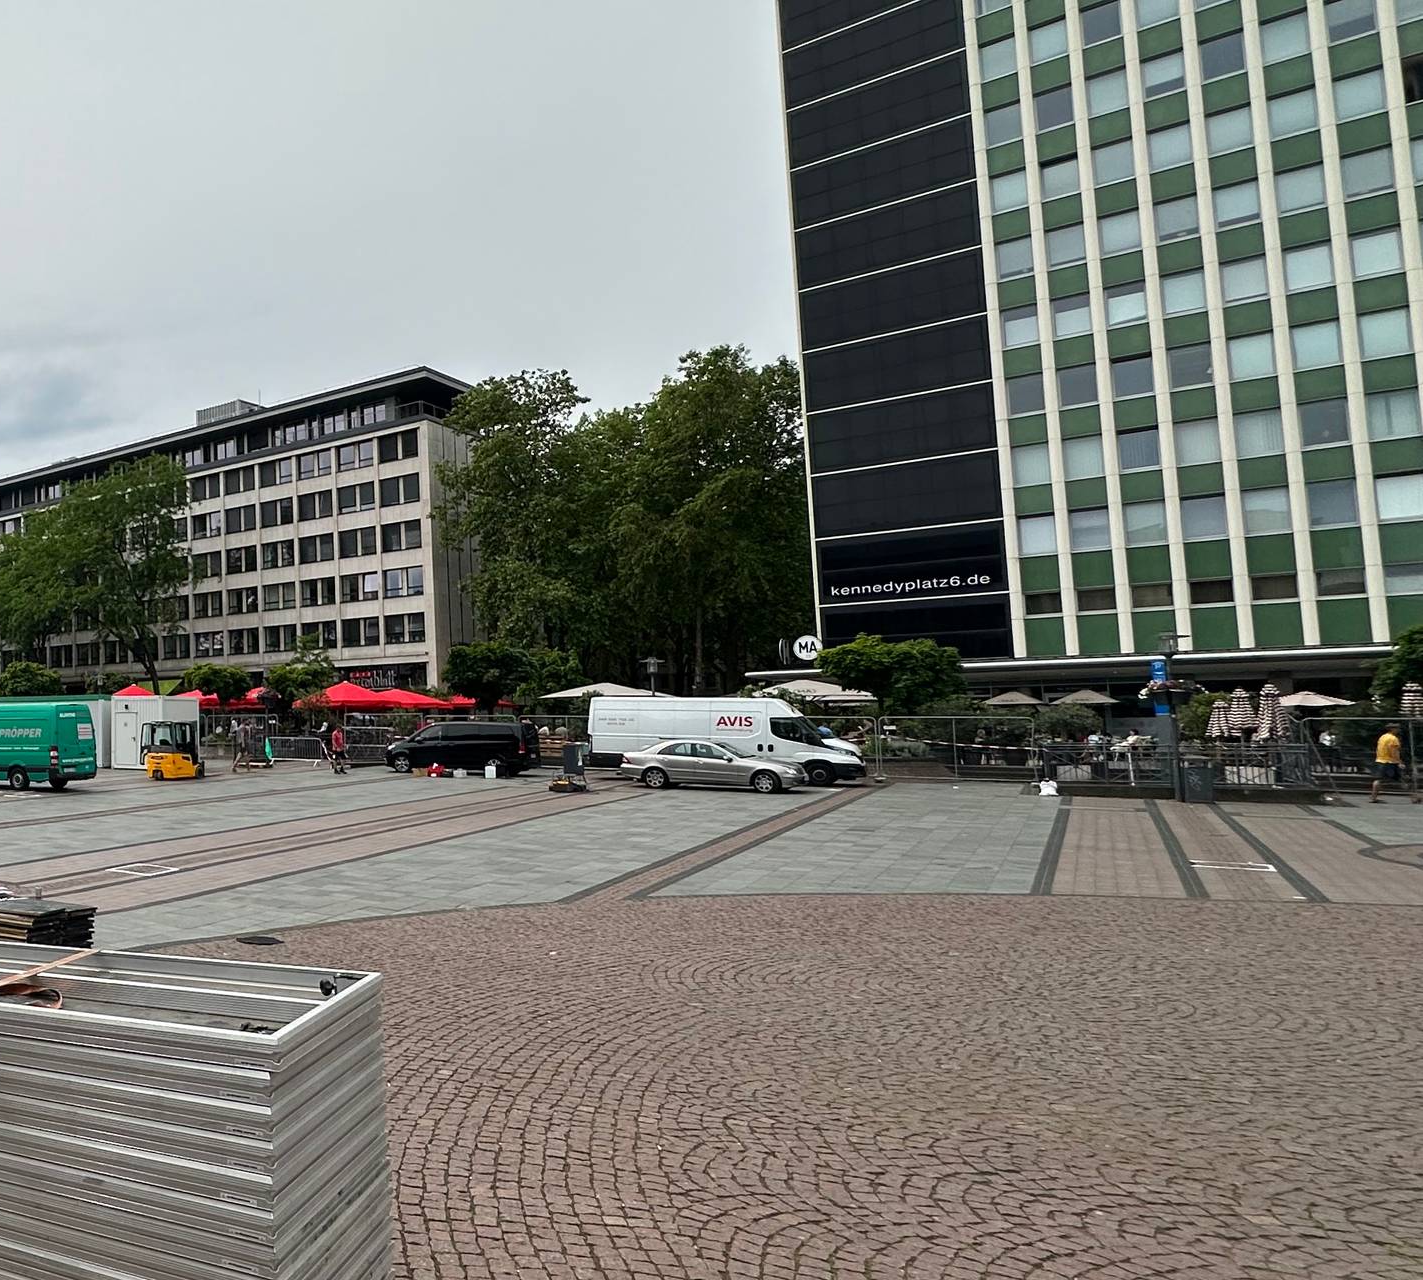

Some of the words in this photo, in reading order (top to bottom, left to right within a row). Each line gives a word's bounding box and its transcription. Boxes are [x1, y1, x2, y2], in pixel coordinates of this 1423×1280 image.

[830, 574, 991, 596] kennedyplatz6.de
[799, 641, 817, 653] MA
[716, 716, 753, 727] AVIS
[0, 726, 42, 739] PRÖPPER
